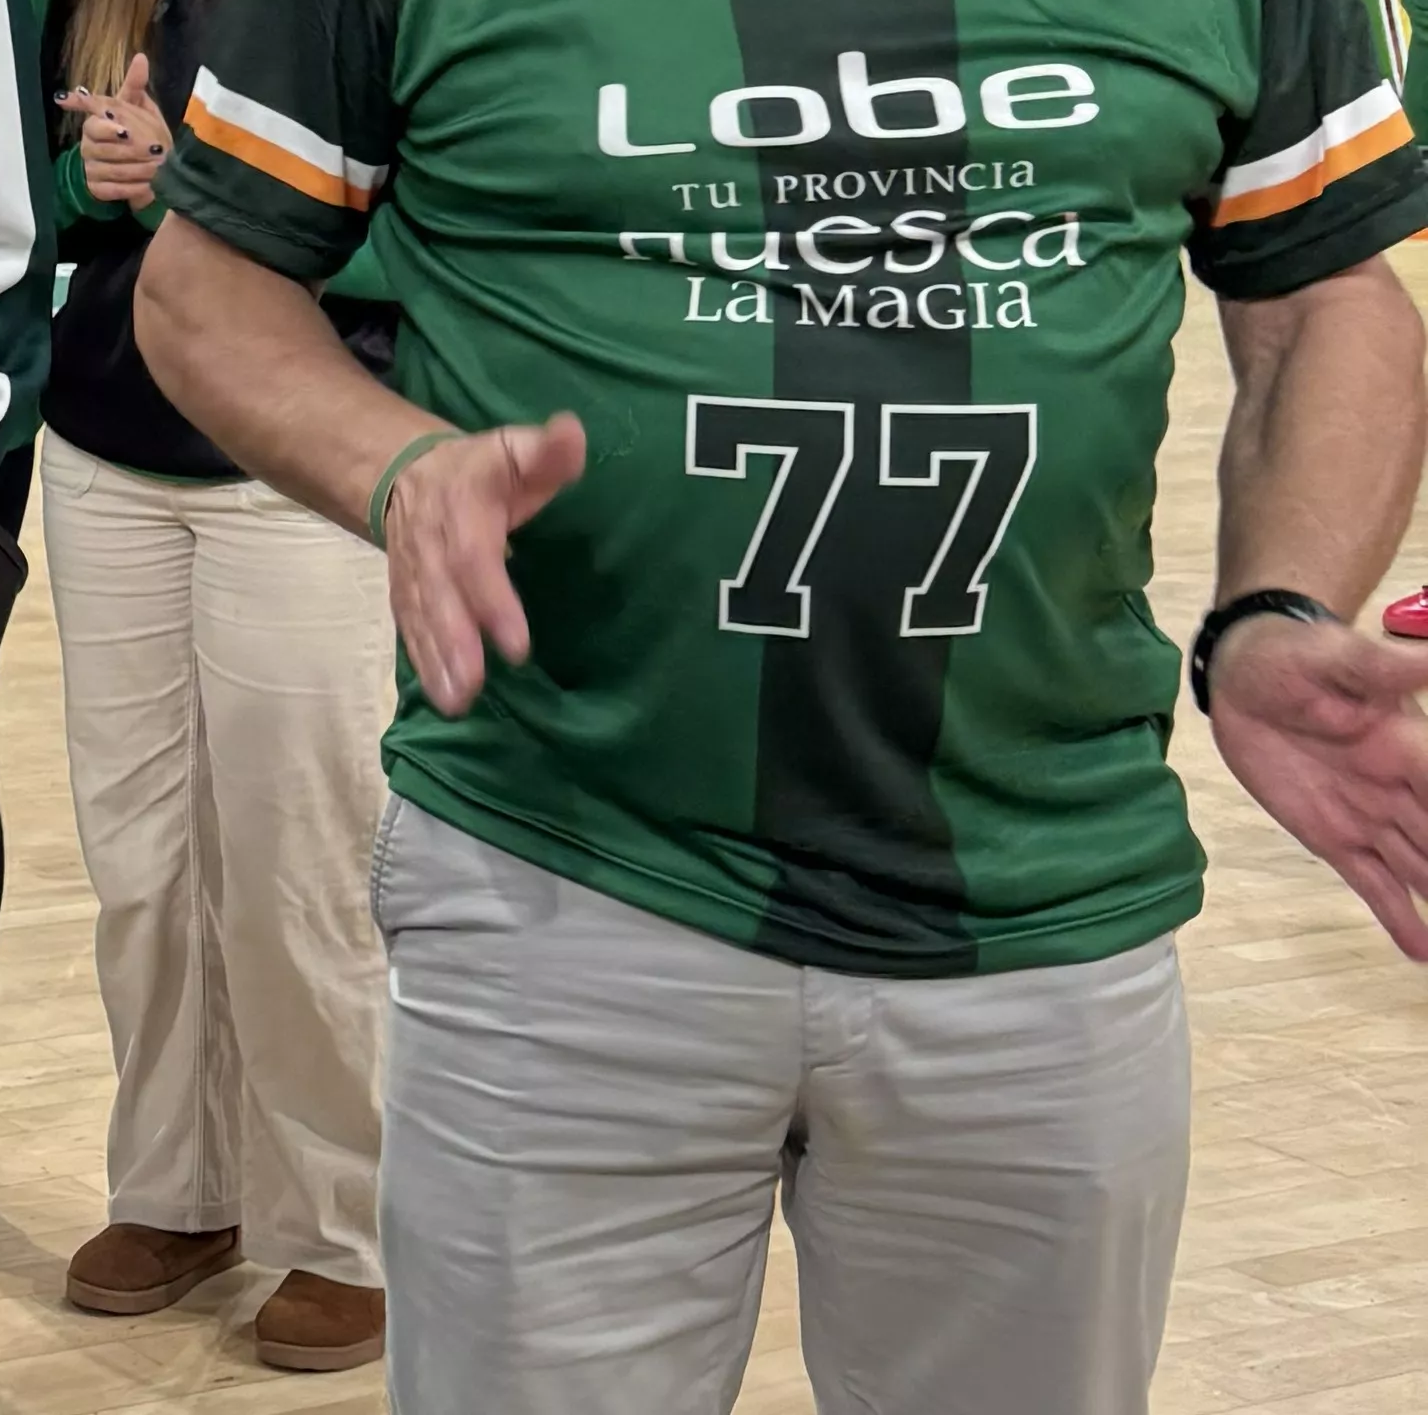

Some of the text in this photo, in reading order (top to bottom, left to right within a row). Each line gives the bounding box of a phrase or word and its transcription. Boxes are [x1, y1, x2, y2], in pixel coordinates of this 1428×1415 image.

[597, 50, 1101, 158] Lobe
[672, 179, 741, 212] Tu
[683, 276, 774, 325] La
[685, 394, 1038, 639] 77
